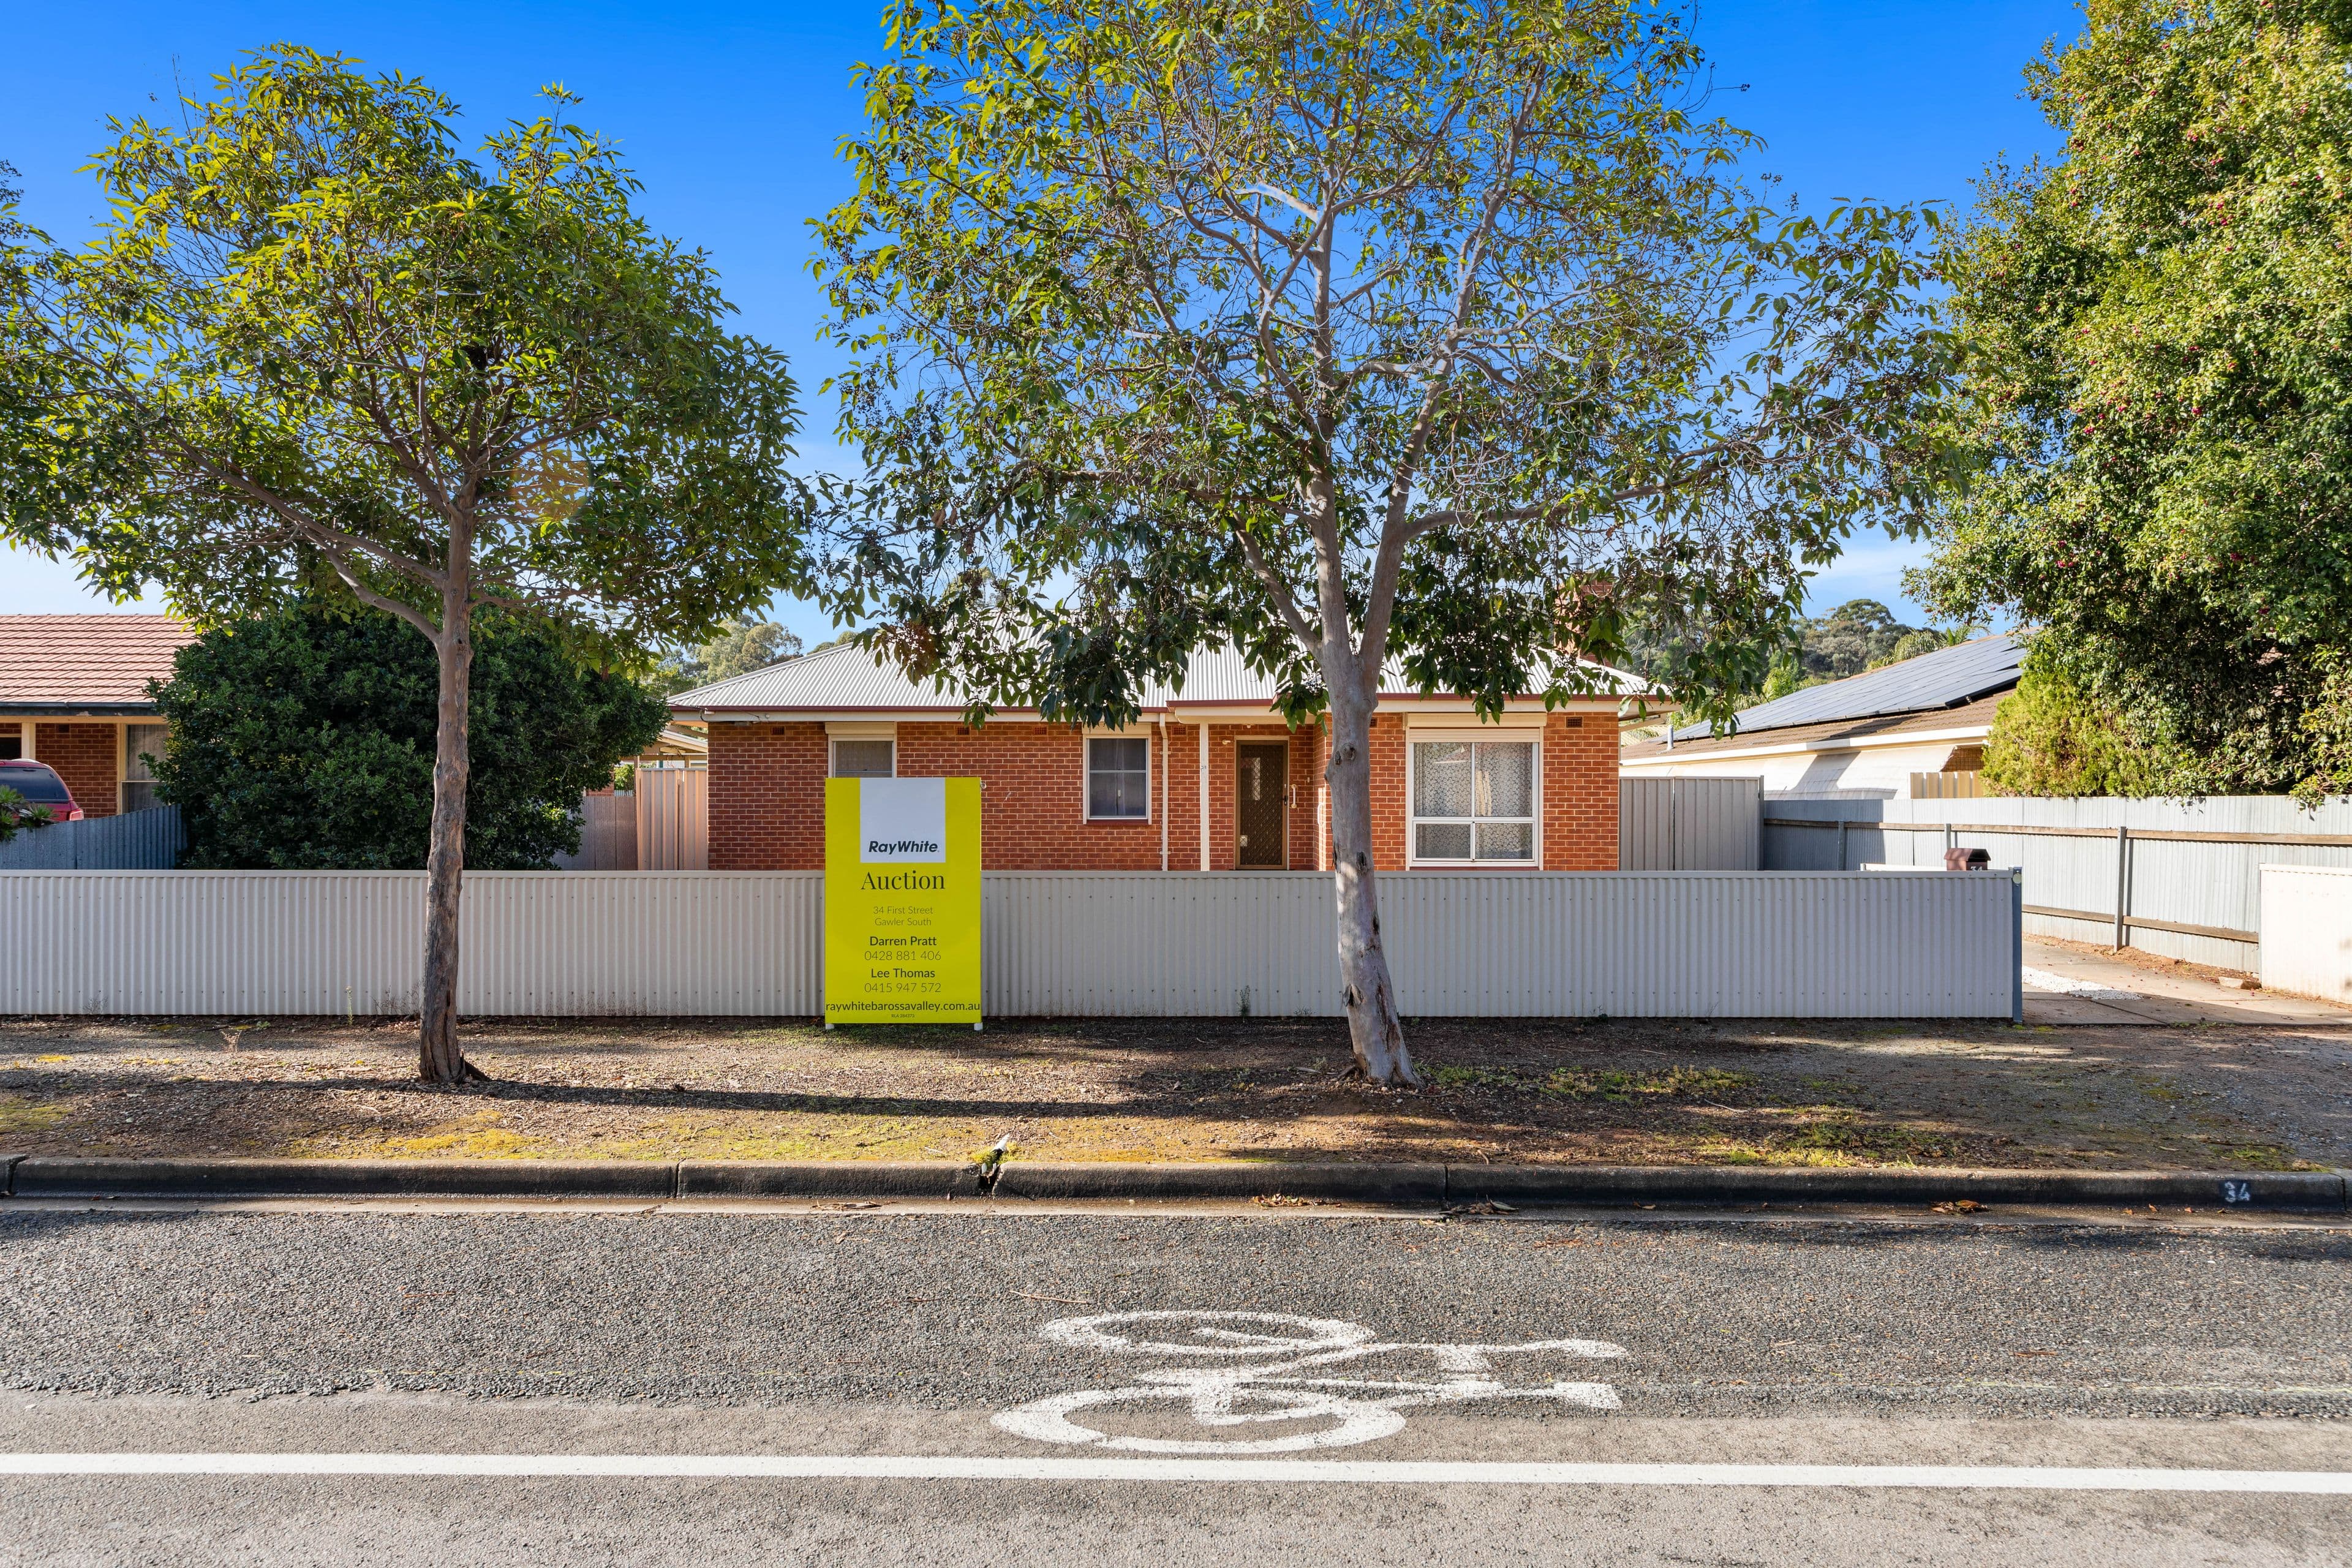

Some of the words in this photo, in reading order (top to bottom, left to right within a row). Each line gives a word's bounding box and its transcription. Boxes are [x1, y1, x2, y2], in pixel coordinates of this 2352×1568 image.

[861, 870, 946, 890] Auction
[873, 906, 884, 914] 34
[887, 906, 905, 914] First
[908, 906, 933, 914] Street
[875, 918, 904, 926] Gawler
[907, 918, 932, 926] South
[870, 937, 907, 946] Darren
[910, 937, 937, 946] Pratt
[864, 951, 892, 960] 0428
[896, 951, 916, 960] 881
[920, 951, 941, 960] 406
[871, 968, 890, 978] Lee
[893, 968, 935, 978] Thomas
[864, 982, 892, 993] 0415
[896, 982, 917, 993] 947
[921, 982, 941, 993] 572
[826, 1001, 981, 1012] raywhitebarossavalley.com.au
[2224, 1181, 2251, 1204] 34
